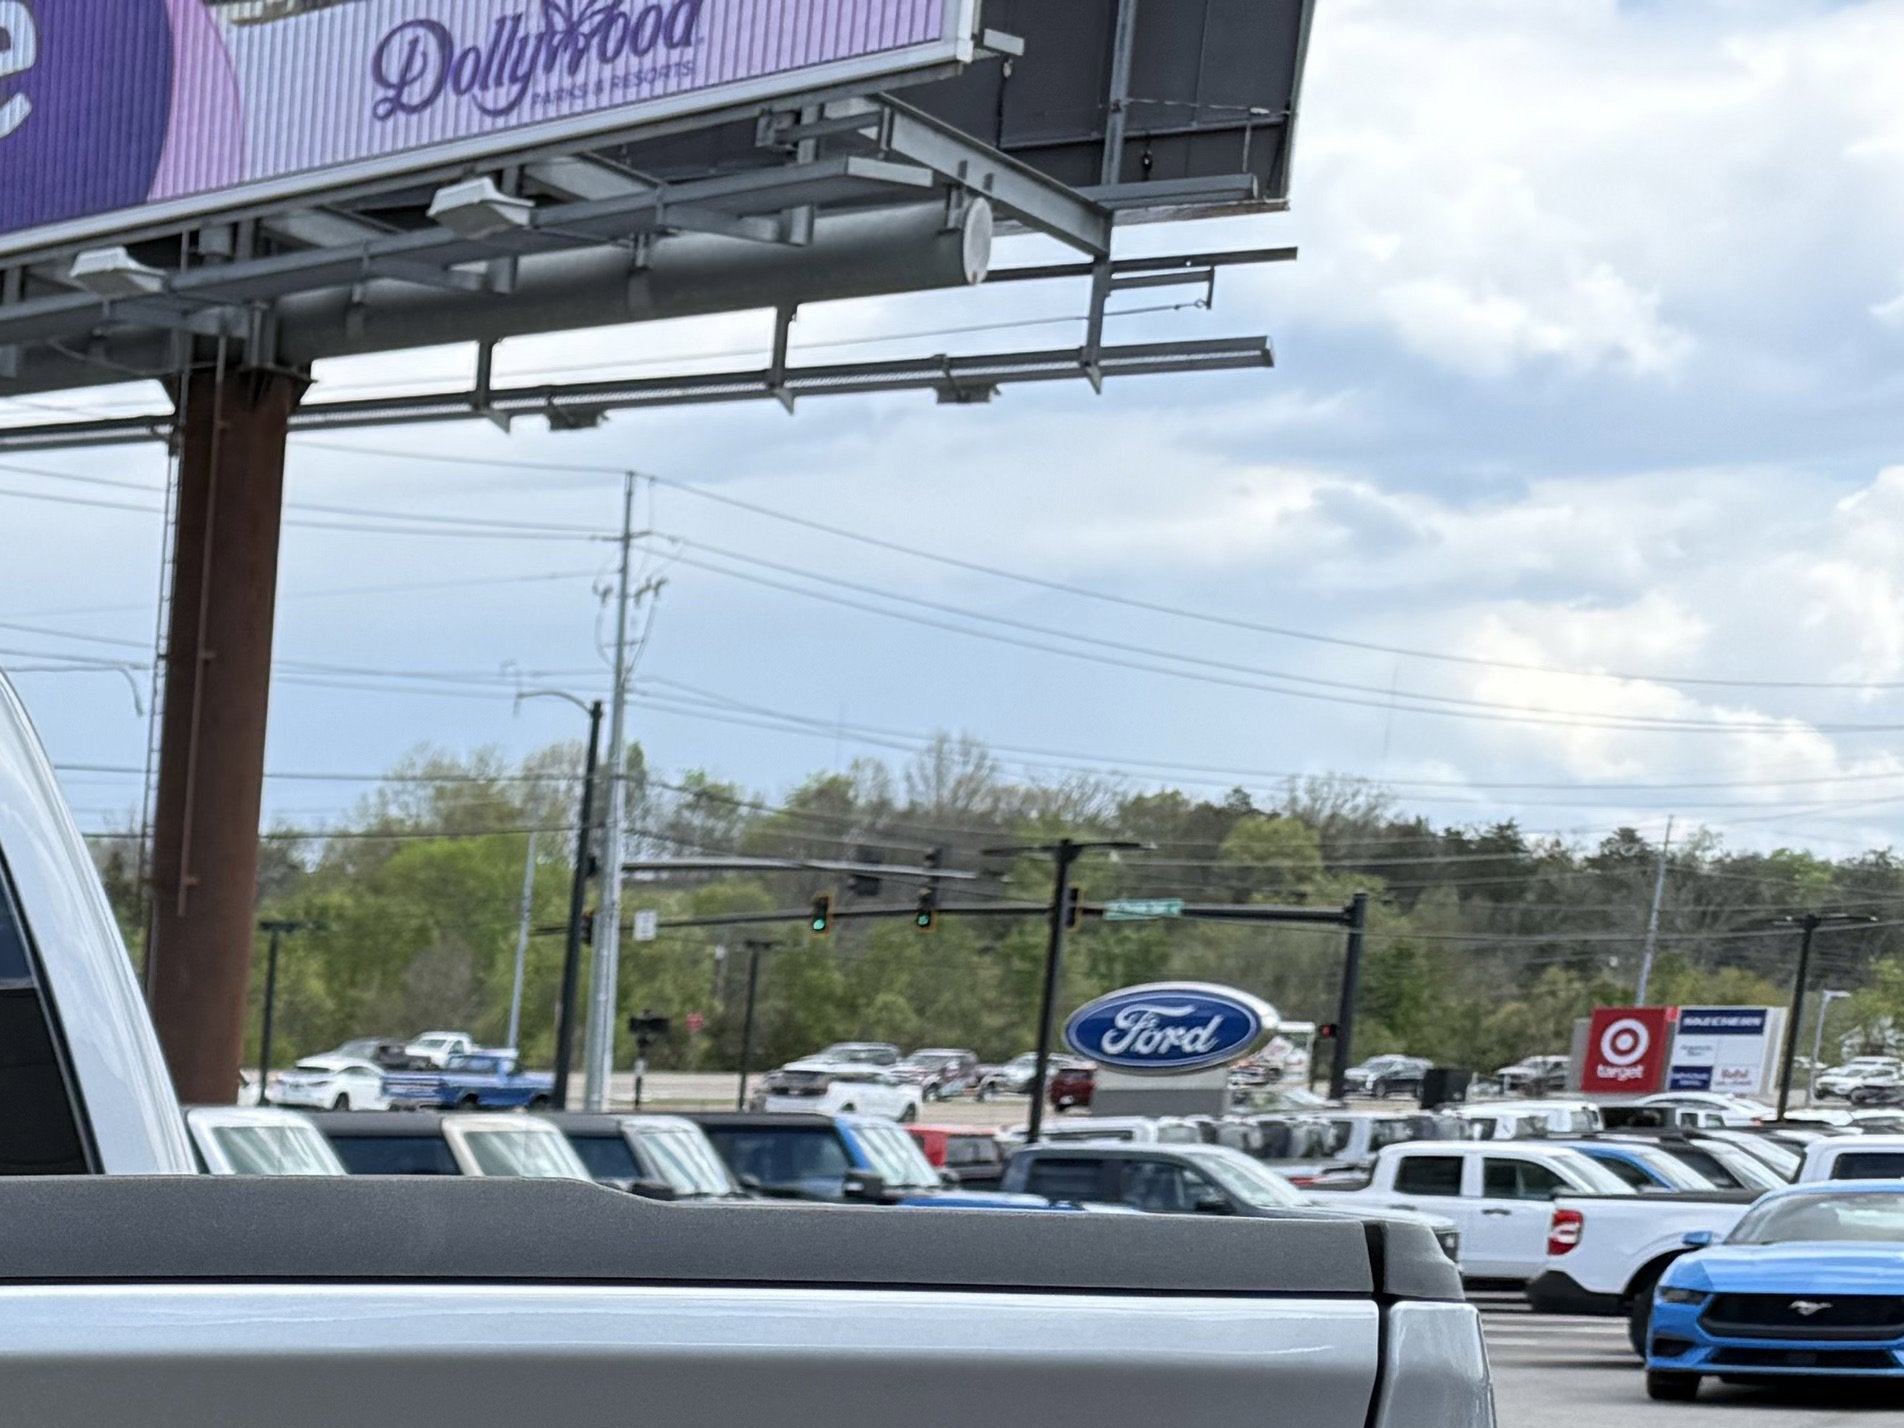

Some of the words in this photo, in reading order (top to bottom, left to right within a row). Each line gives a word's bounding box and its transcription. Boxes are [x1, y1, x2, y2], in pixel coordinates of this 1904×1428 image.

[531, 82, 588, 107] PARKS
[611, 60, 694, 90] RESORTS
[1100, 1003, 1225, 1055] Ford
